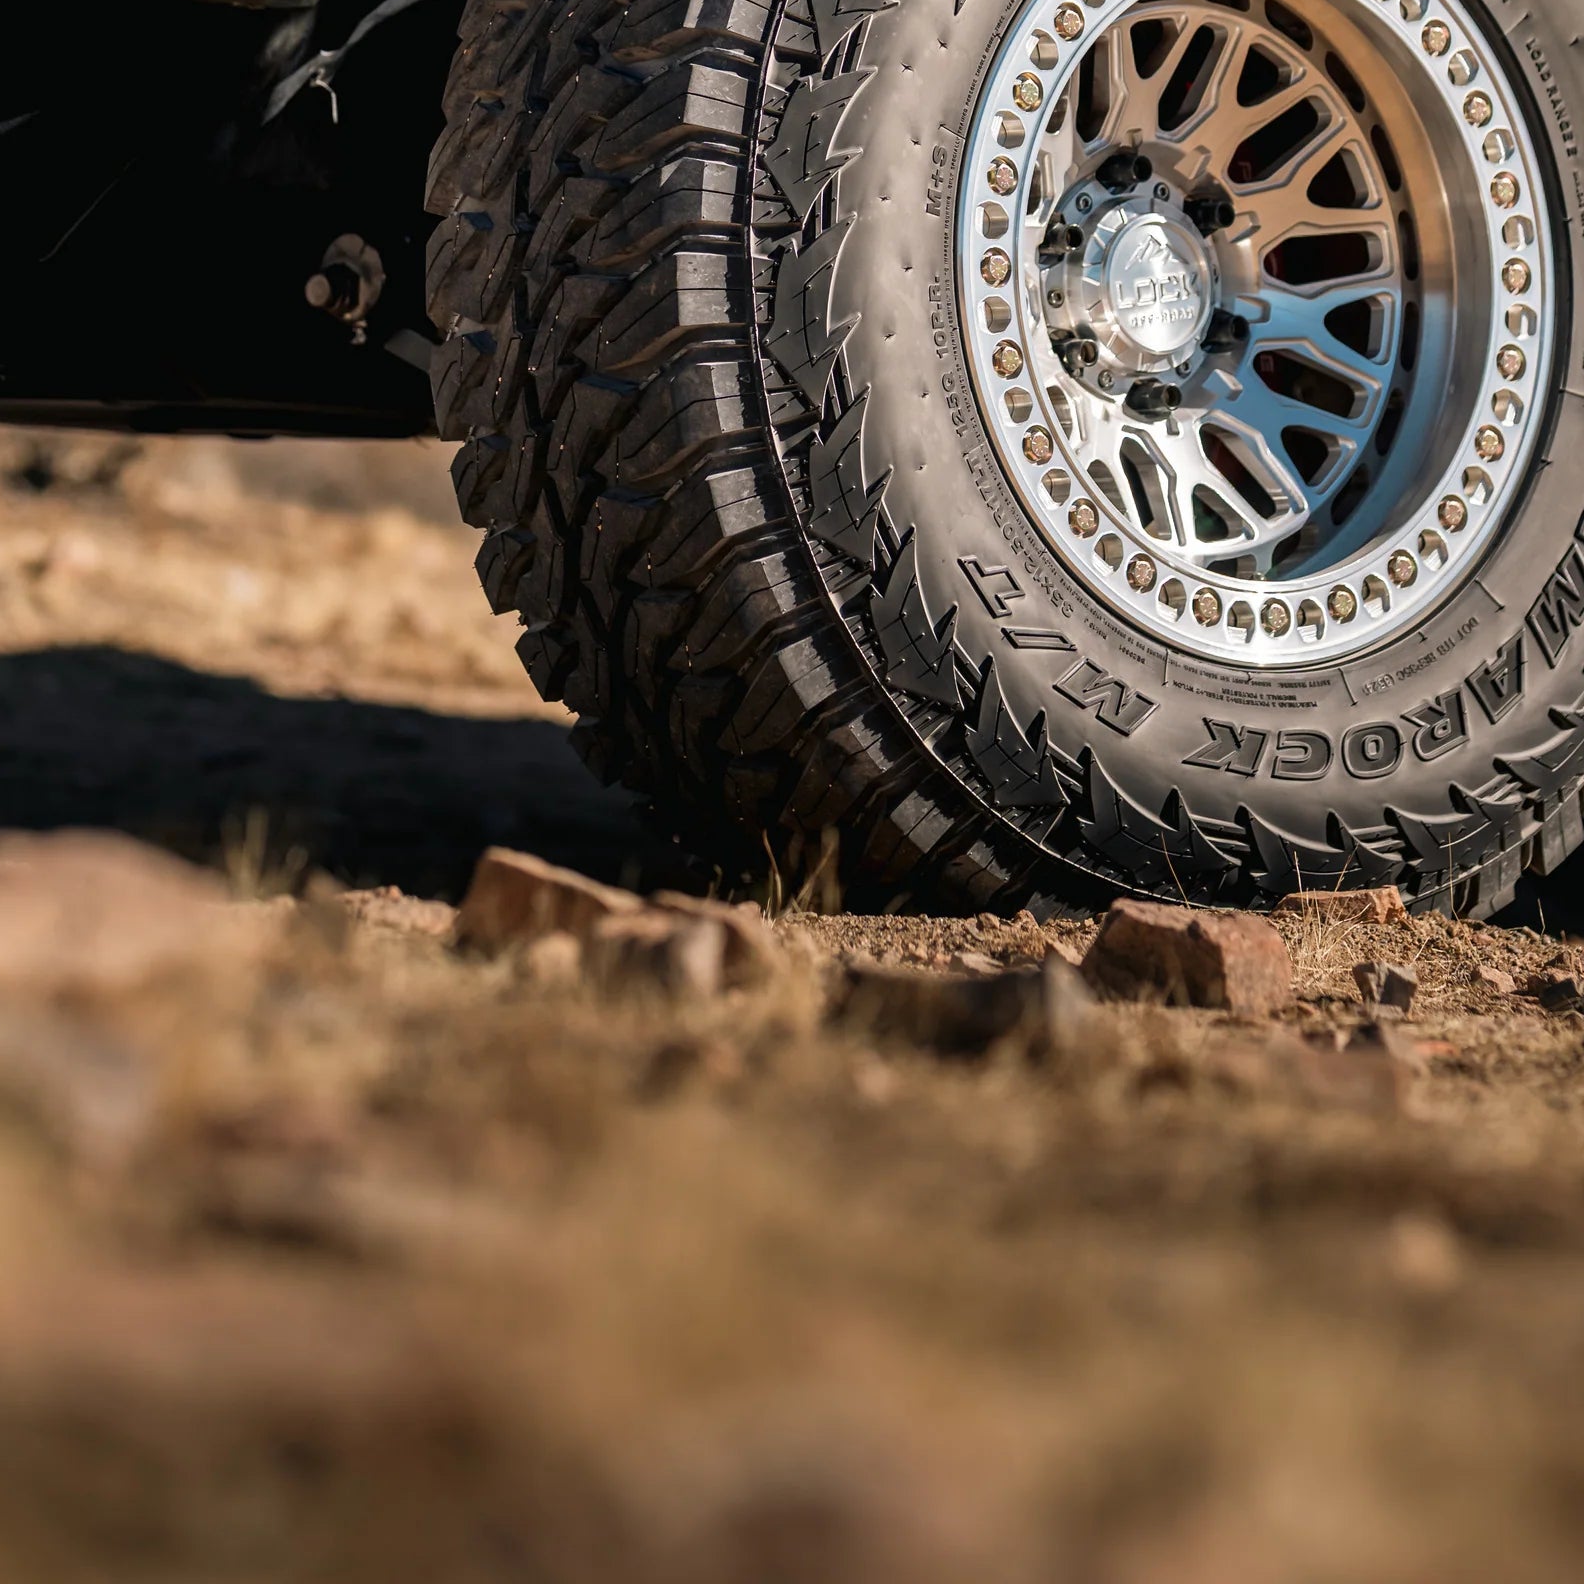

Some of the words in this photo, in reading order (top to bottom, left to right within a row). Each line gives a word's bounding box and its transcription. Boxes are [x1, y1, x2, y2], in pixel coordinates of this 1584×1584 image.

[1525, 36, 1550, 83] LOAD
[1546, 84, 1577, 145] RANGE
[925, 143, 948, 217] M+S
[940, 370, 968, 439] 125Q
[956, 555, 1161, 738] M/T
[1457, 616, 1480, 641] DOT
